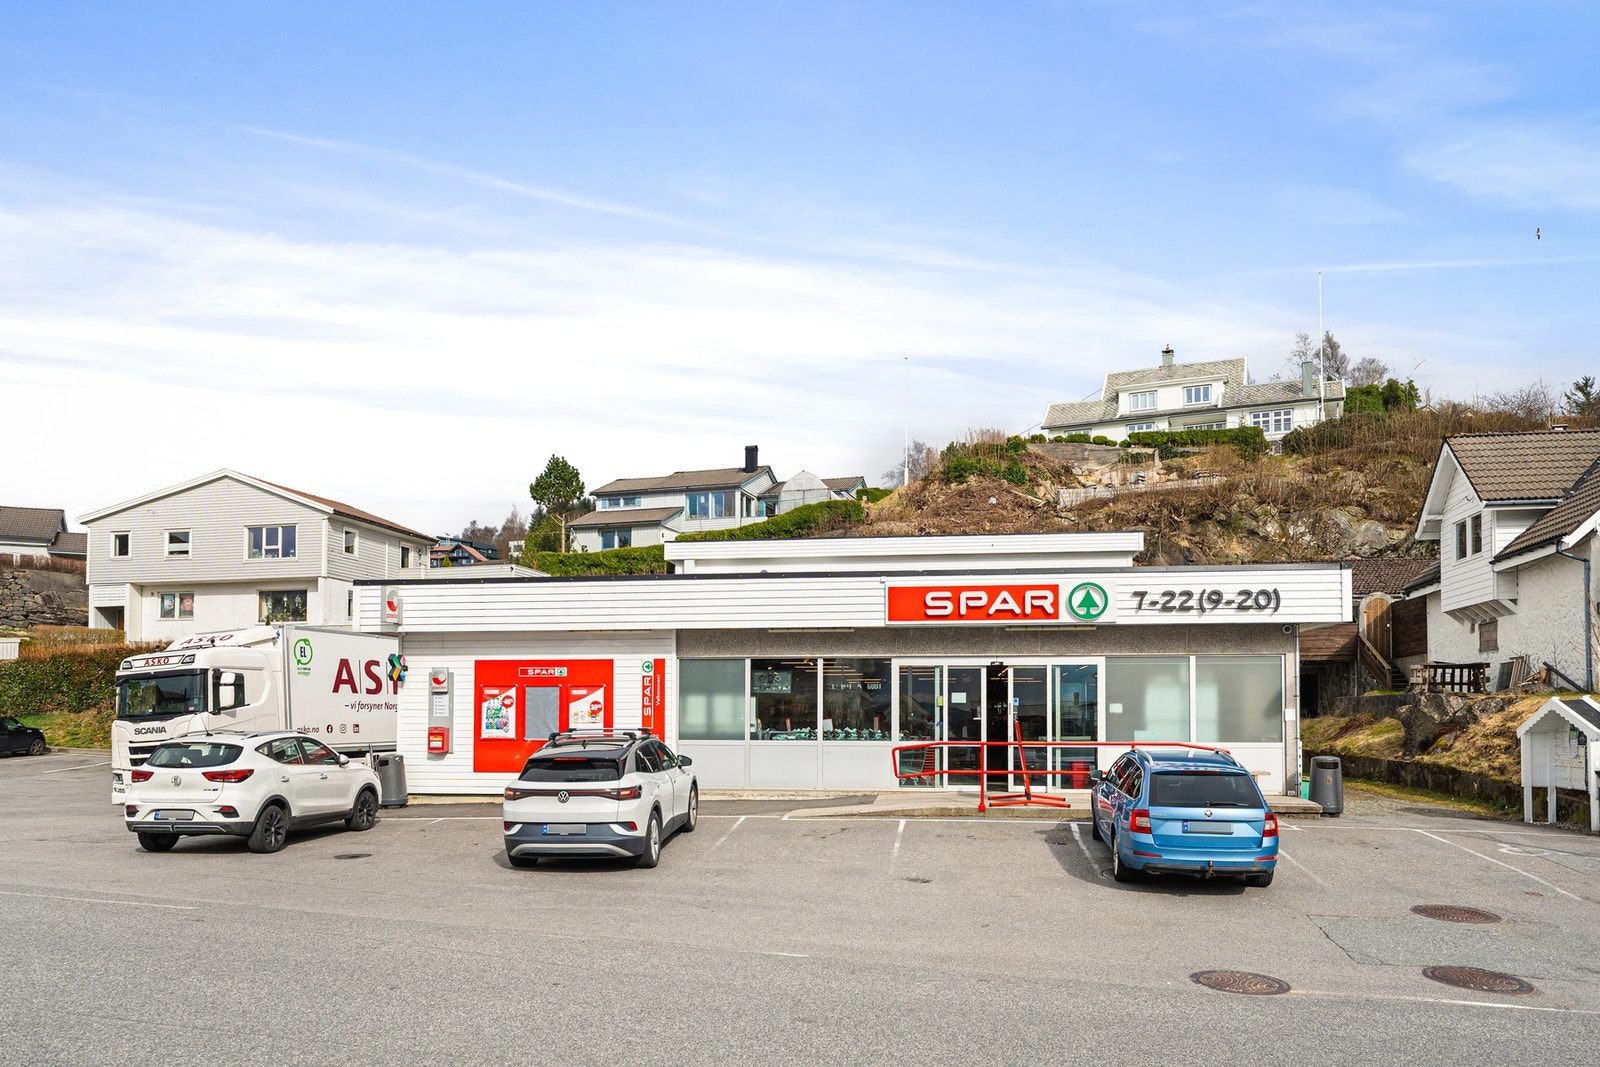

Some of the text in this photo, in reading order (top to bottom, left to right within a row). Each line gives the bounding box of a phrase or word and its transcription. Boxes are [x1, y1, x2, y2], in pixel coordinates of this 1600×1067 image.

[925, 590, 1055, 616] SPAR
[1131, 587, 1282, 614] 7-22(9-20)
[300, 646, 307, 658] EL
[143, 656, 170, 667] ASKO
[332, 658, 399, 695] AS
[527, 668, 555, 676] SPAR
[643, 676, 652, 716] SPAR
[356, 701, 383, 713] forsyner
[134, 726, 167, 736] SCANIA
